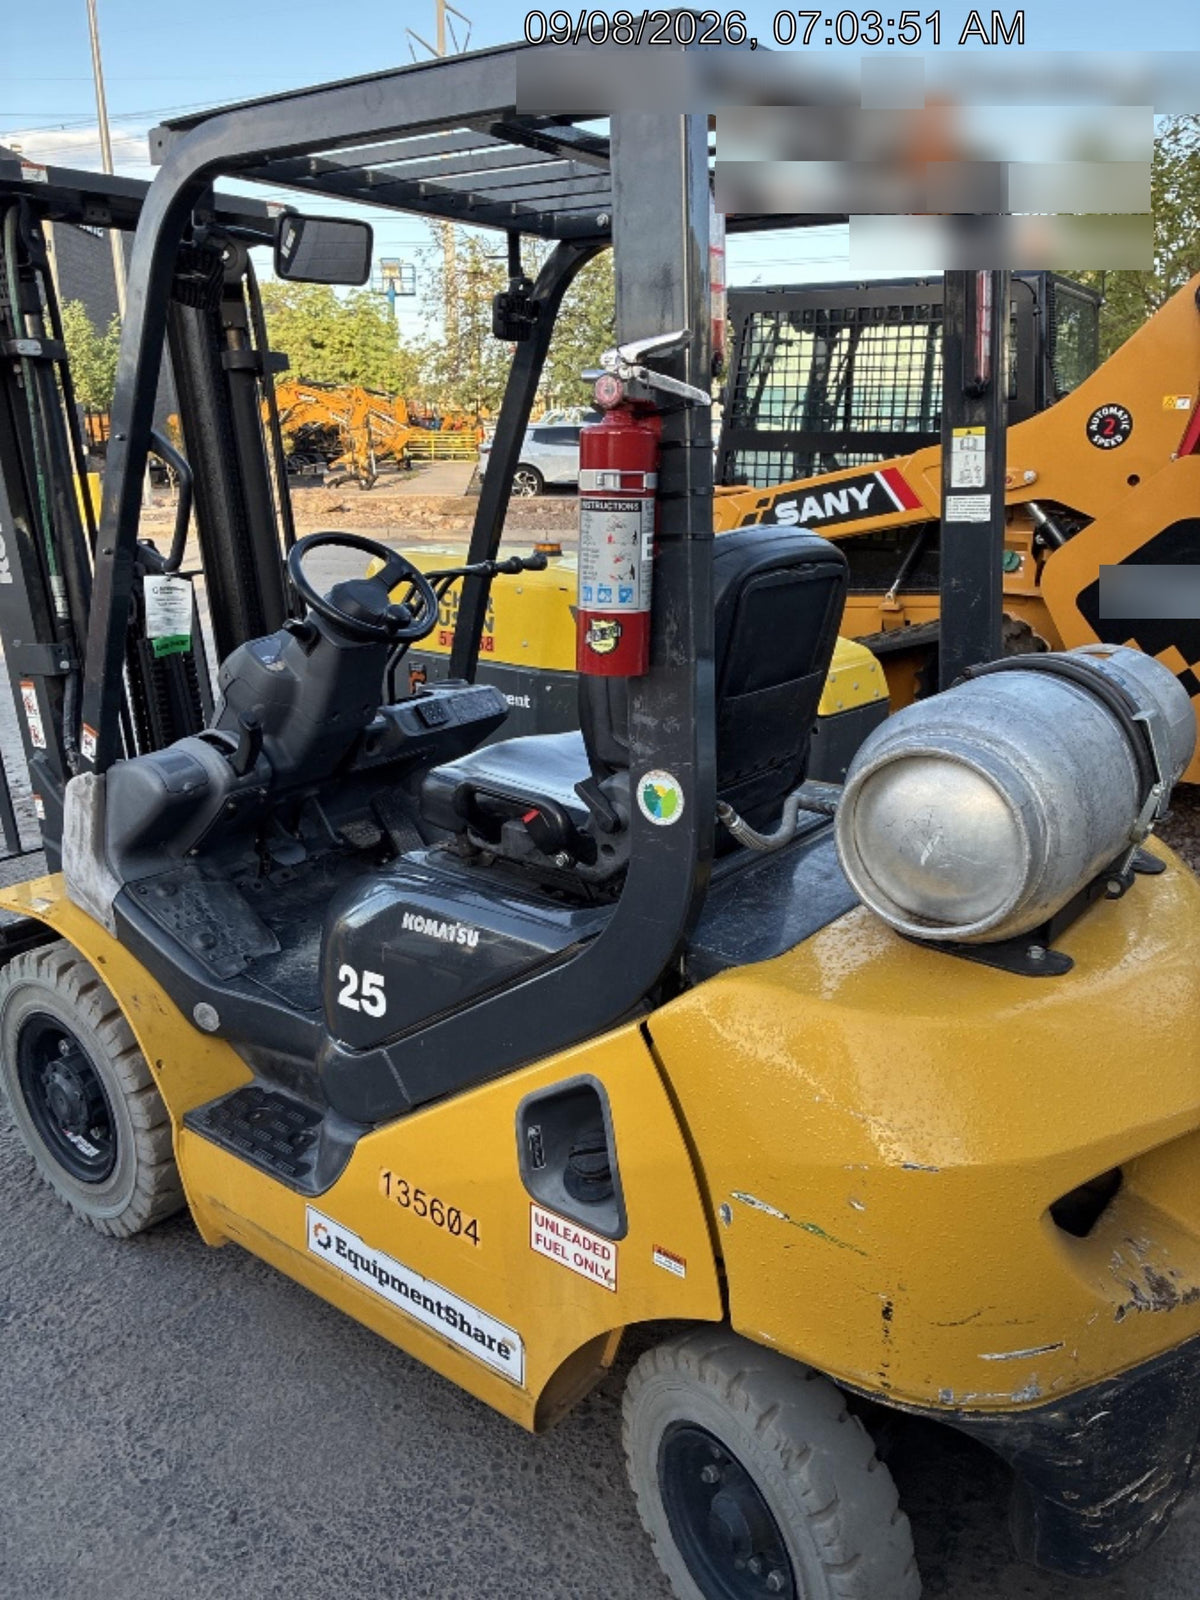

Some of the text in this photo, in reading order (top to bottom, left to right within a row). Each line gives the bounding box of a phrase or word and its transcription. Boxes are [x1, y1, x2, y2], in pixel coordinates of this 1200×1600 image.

[1089, 406, 1130, 431] AUTOMATIC
[1103, 418, 1116, 435] 2
[1092, 434, 1123, 447] SPEED
[583, 500, 639, 511] NSTRUCTIONS
[774, 483, 875, 525] SANY
[401, 912, 480, 947] KOMATSU
[337, 963, 387, 1018] 25
[383, 1171, 480, 1247] 135604
[534, 1212, 611, 1260] UNLEADED
[534, 1232, 612, 1281] FUEL ONLY
[334, 1236, 511, 1360] EquipmentShare
